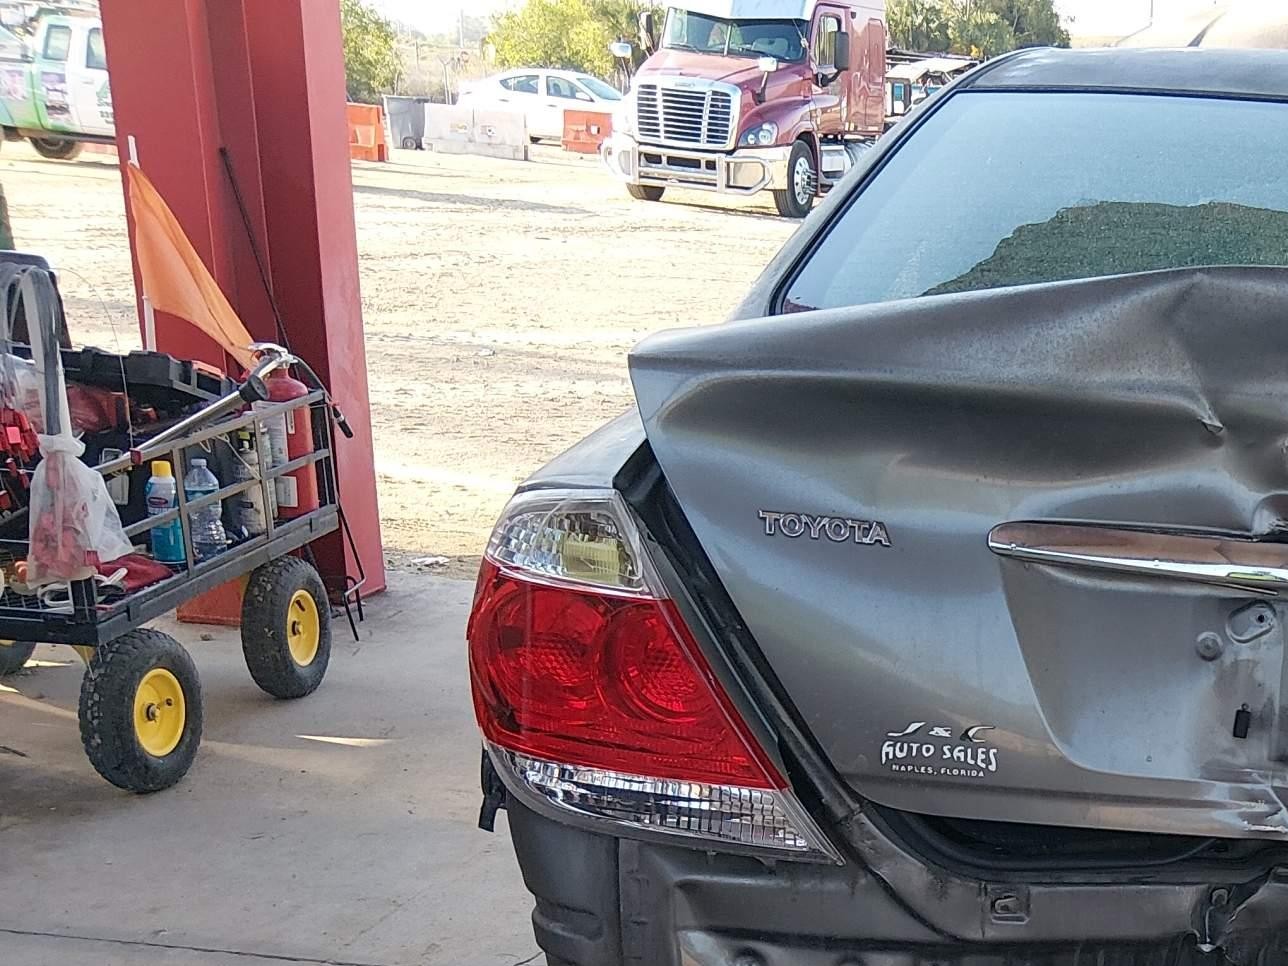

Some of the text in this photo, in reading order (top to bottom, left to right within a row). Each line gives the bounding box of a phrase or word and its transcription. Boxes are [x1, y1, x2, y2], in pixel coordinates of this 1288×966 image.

[758, 510, 892, 547] TOYOTA
[960, 725, 996, 743] C
[881, 740, 998, 772] AUTO SALES
[892, 764, 985, 777] NAPLES, FLORIDA
